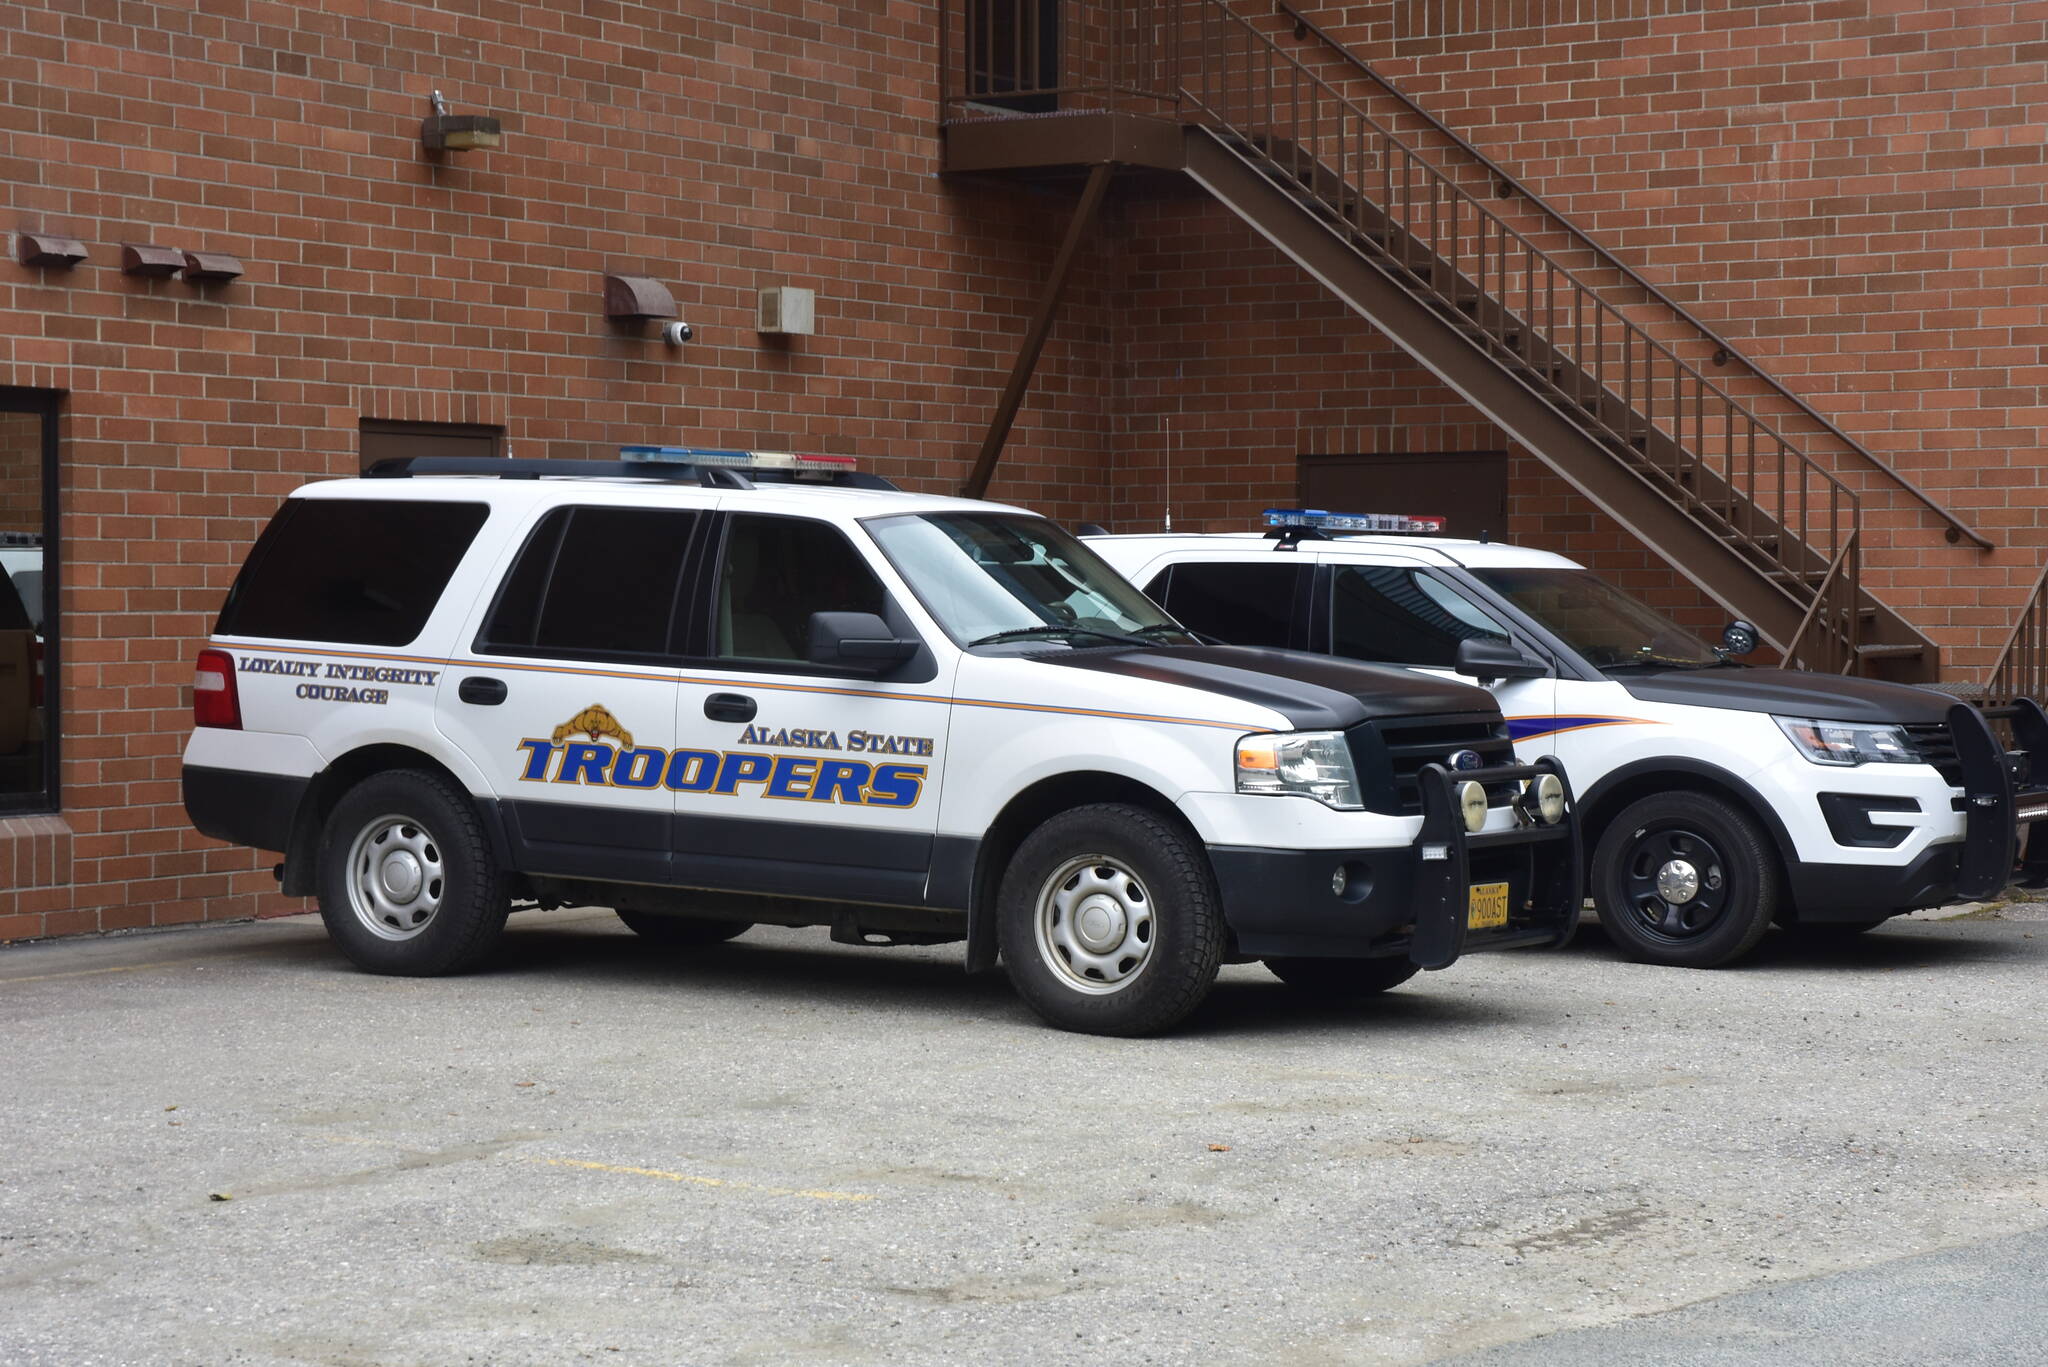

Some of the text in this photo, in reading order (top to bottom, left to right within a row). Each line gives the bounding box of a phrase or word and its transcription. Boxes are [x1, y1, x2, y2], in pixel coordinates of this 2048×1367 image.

[238, 657, 440, 686] LOYALTY INTEGRITY
[296, 683, 388, 704] COURAGE
[737, 723, 934, 757] ALASKA STATE
[516, 737, 928, 809] TROOPERS
